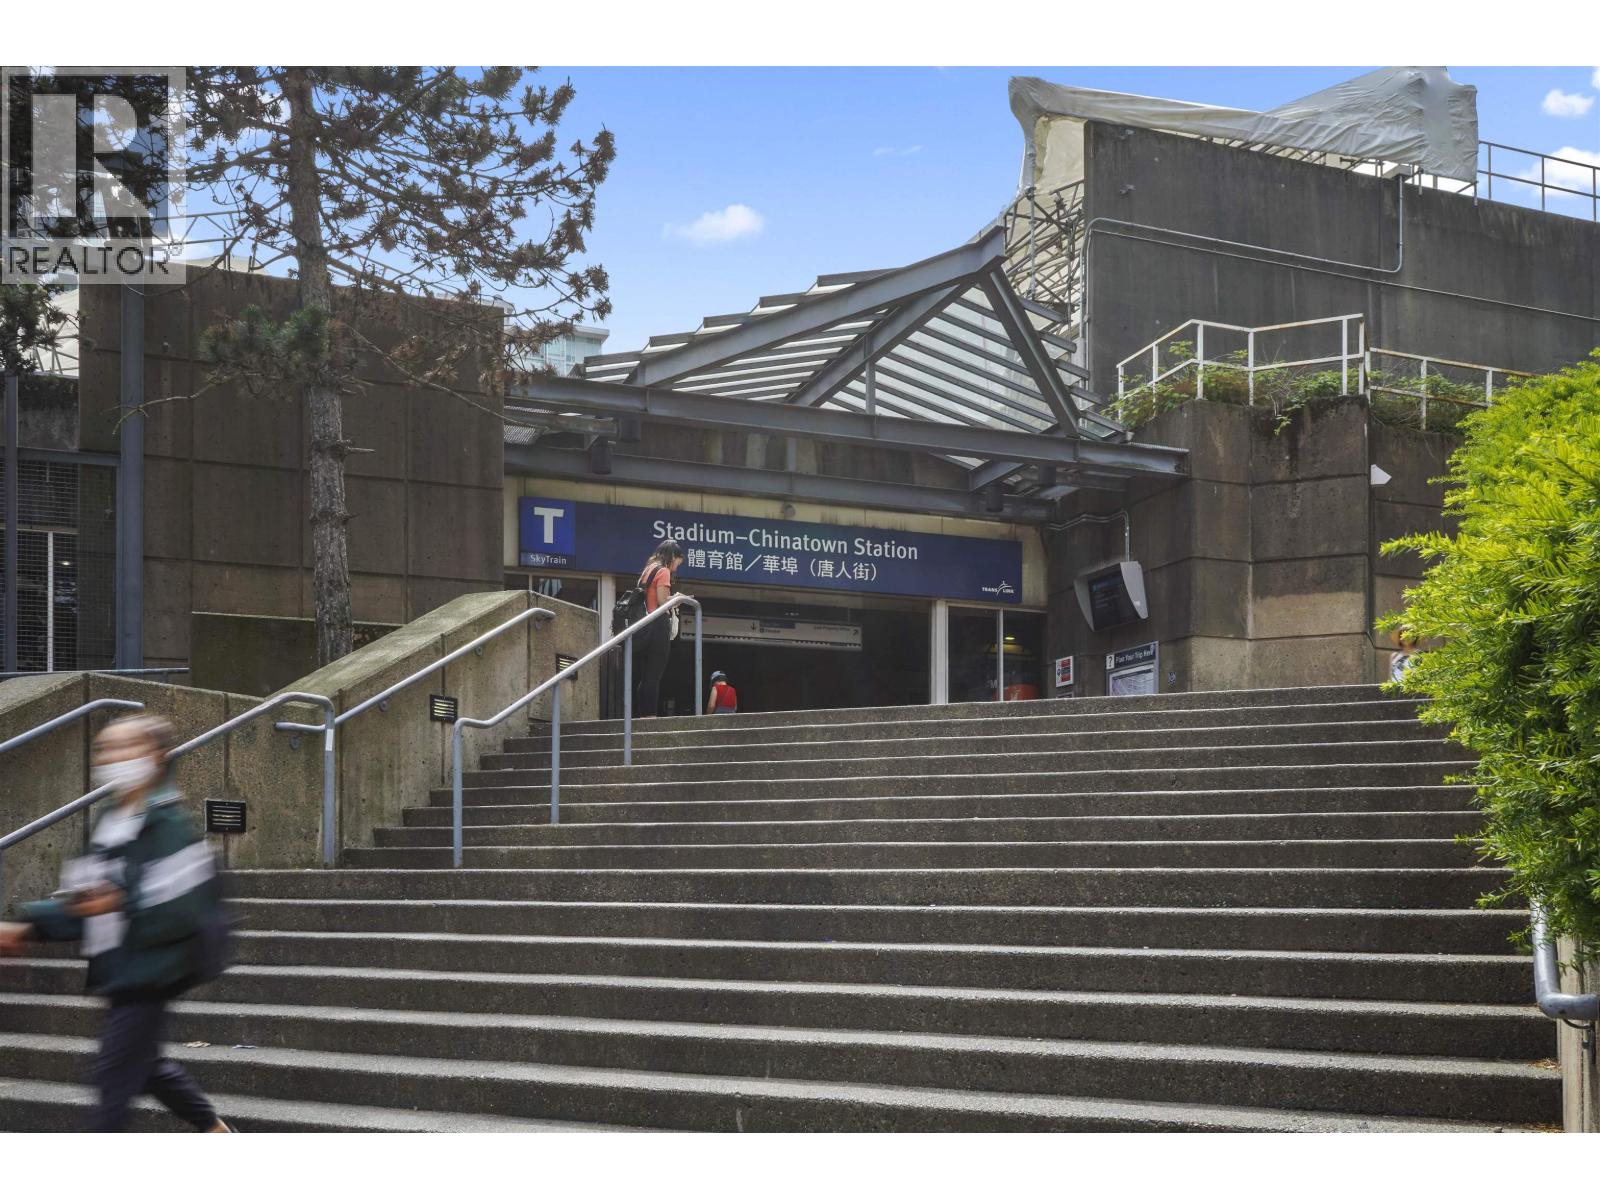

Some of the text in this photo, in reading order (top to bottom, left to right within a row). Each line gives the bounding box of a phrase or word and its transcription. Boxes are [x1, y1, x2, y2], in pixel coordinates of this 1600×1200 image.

[533, 506, 565, 544] T
[530, 554, 567, 565] SkyTrain
[854, 538, 918, 560] Station
